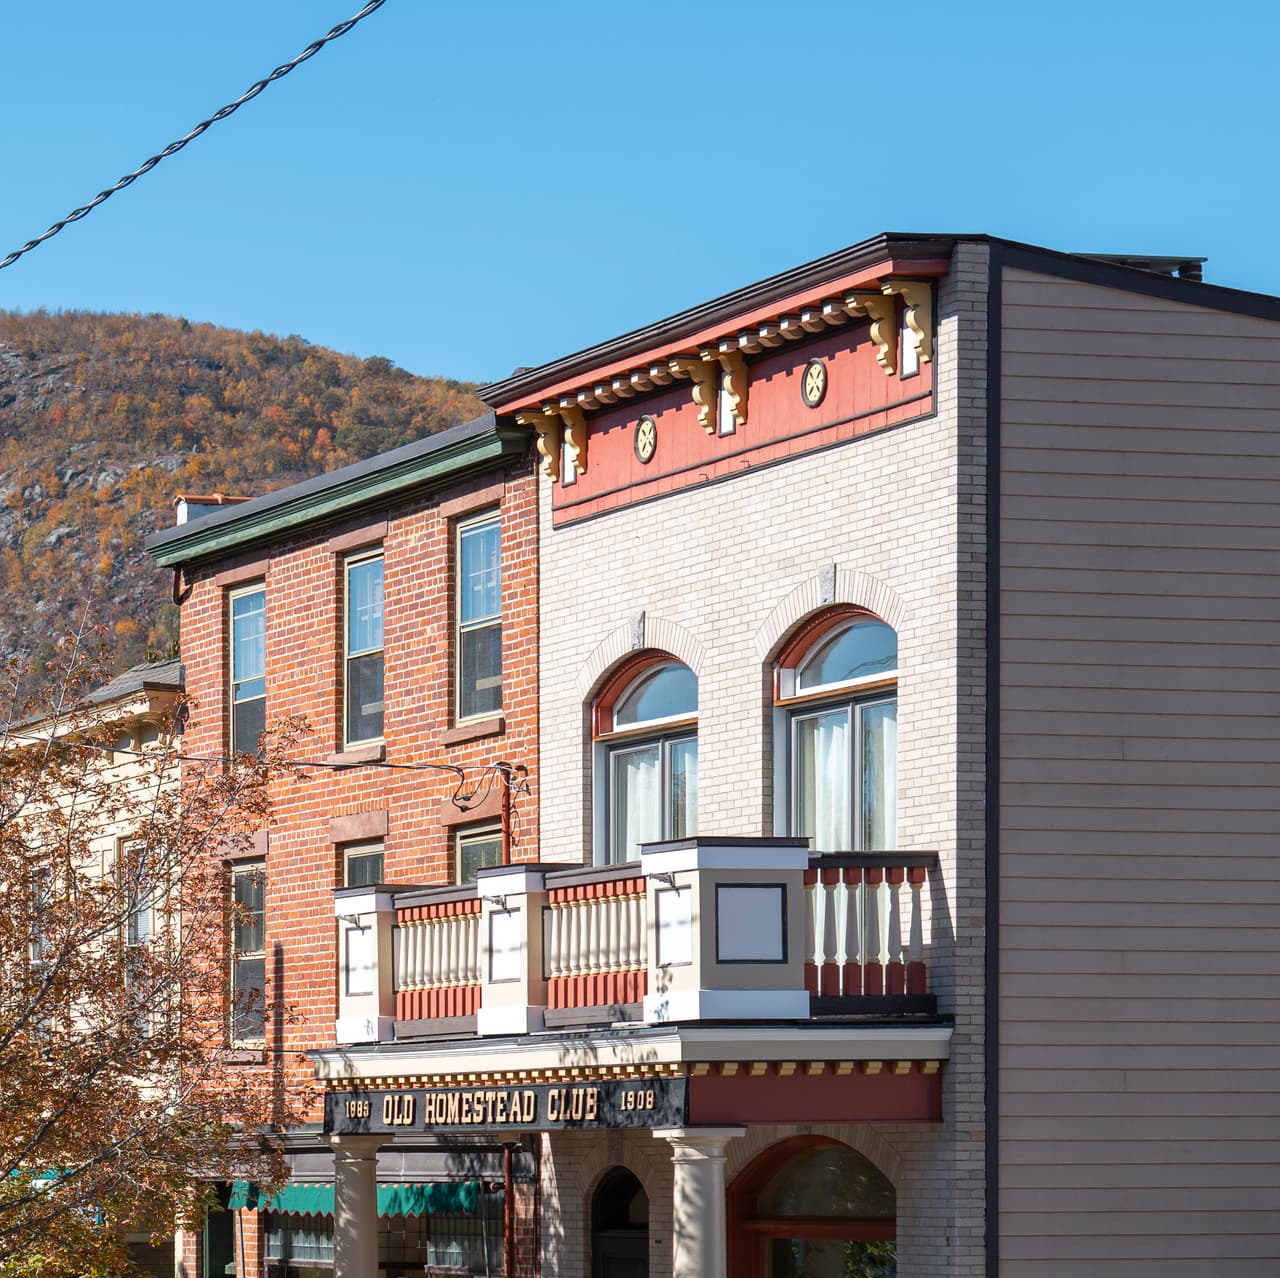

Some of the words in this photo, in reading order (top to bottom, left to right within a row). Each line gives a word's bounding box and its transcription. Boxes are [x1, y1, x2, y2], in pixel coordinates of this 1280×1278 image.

[382, 1094, 413, 1125] OLD
[425, 1090, 535, 1124] HOMESTEAD
[547, 1087, 598, 1121] CLUB
[621, 1090, 654, 1111] 1908
